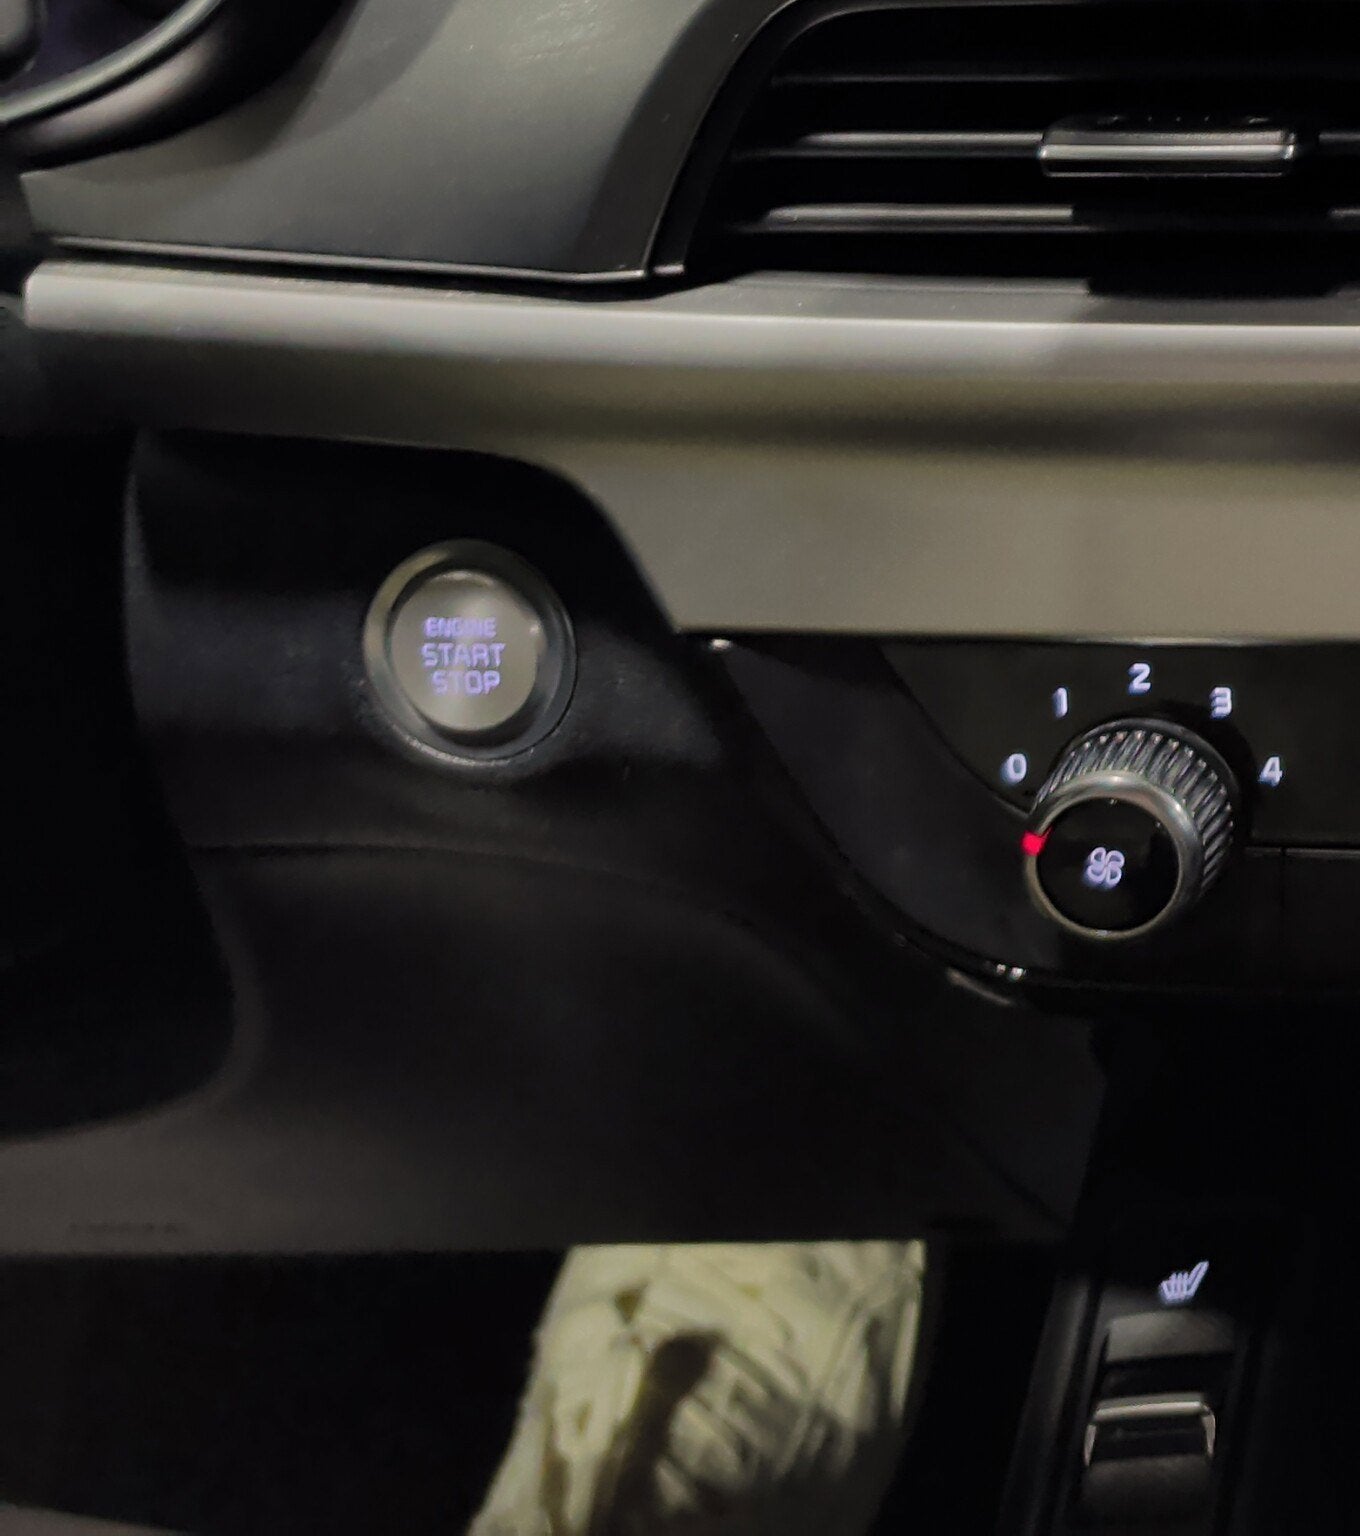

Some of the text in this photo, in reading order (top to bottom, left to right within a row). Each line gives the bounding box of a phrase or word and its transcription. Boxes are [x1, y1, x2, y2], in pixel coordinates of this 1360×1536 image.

[424, 617, 497, 638] ENGINE
[421, 643, 506, 667] START
[431, 670, 500, 694] STOP
[1128, 662, 1151, 693] 2
[1055, 687, 1068, 716] 1
[1211, 686, 1233, 718] 3
[1003, 753, 1027, 783] 0
[1259, 756, 1283, 786] 4
